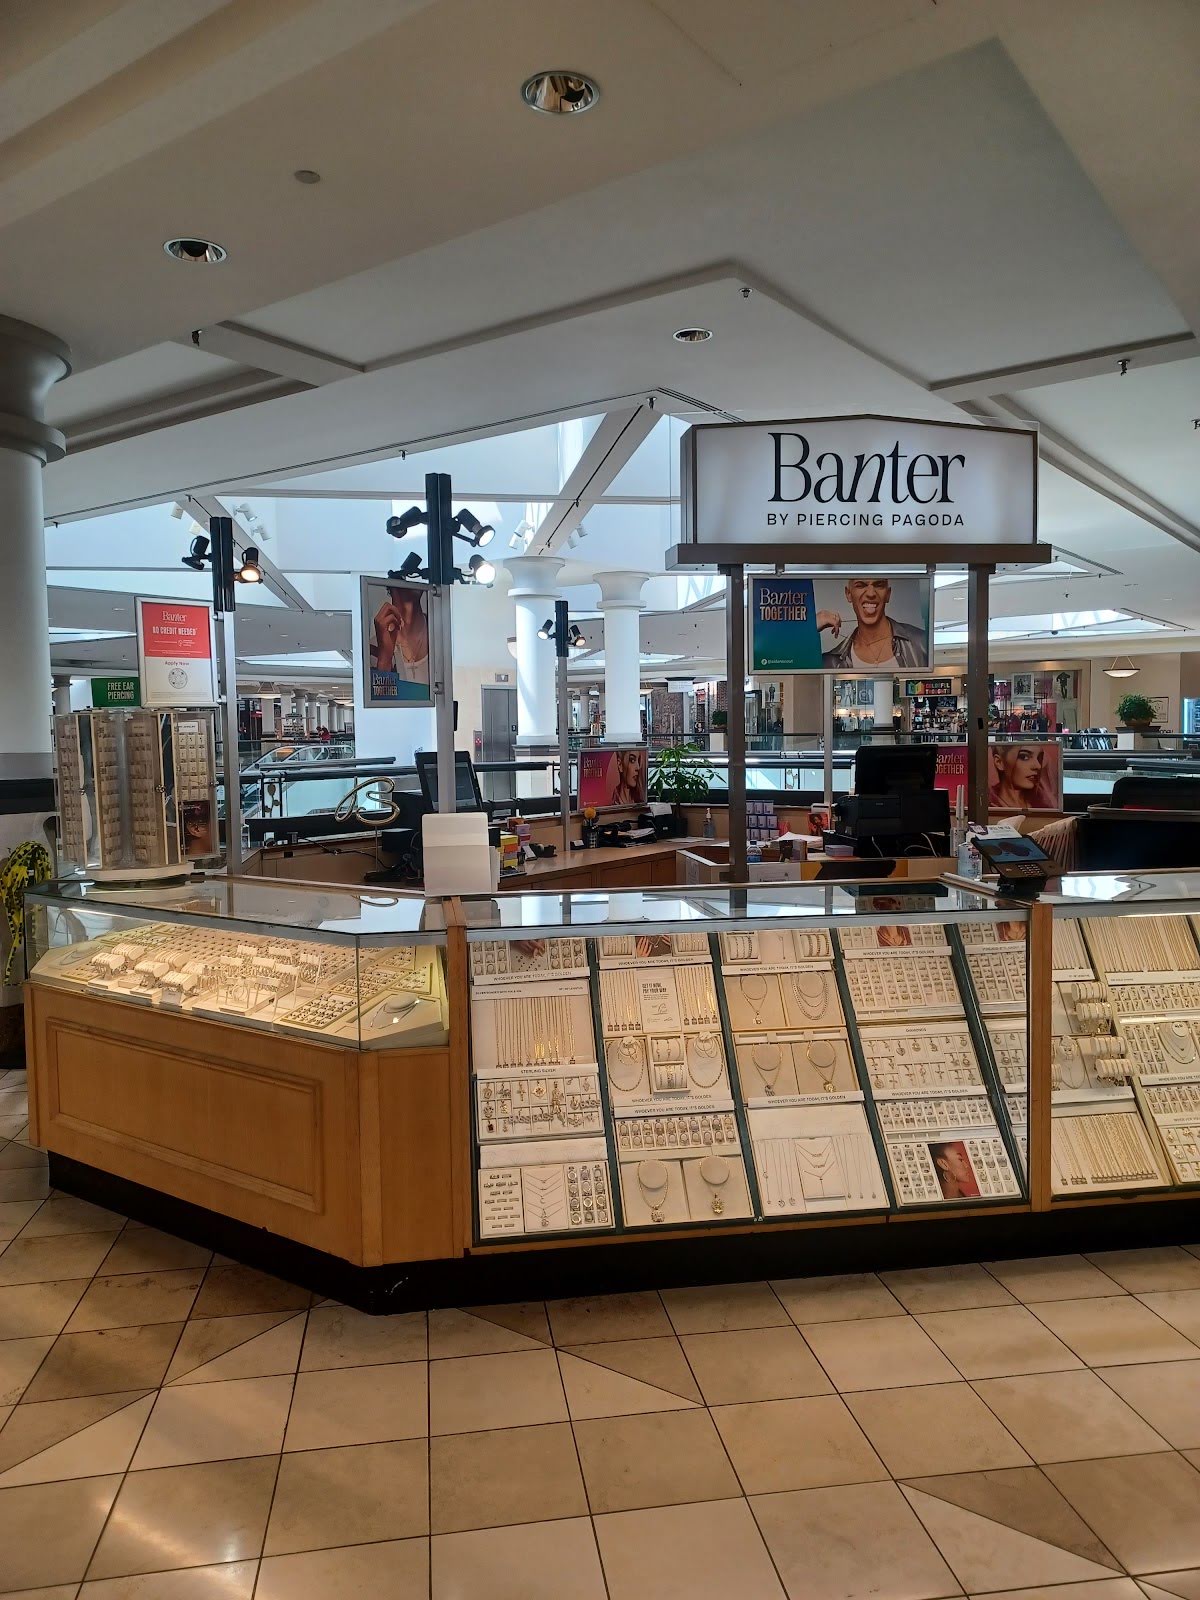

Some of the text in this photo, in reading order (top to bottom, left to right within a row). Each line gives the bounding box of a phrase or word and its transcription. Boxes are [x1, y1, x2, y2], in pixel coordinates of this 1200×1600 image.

[767, 432, 966, 504] Banter
[767, 513, 965, 526] BY PIERCING PAGODA
[760, 587, 808, 606] Banter
[162, 610, 187, 622] Banter
[760, 606, 807, 621] TOGETHER
[152, 626, 160, 634] NO
[160, 626, 177, 635] CREDIT
[107, 681, 134, 690] FREE EAR
[372, 685, 398, 696] TOGETHER
[107, 691, 134, 700] PIERCING
[935, 764, 964, 775] OGETHER
